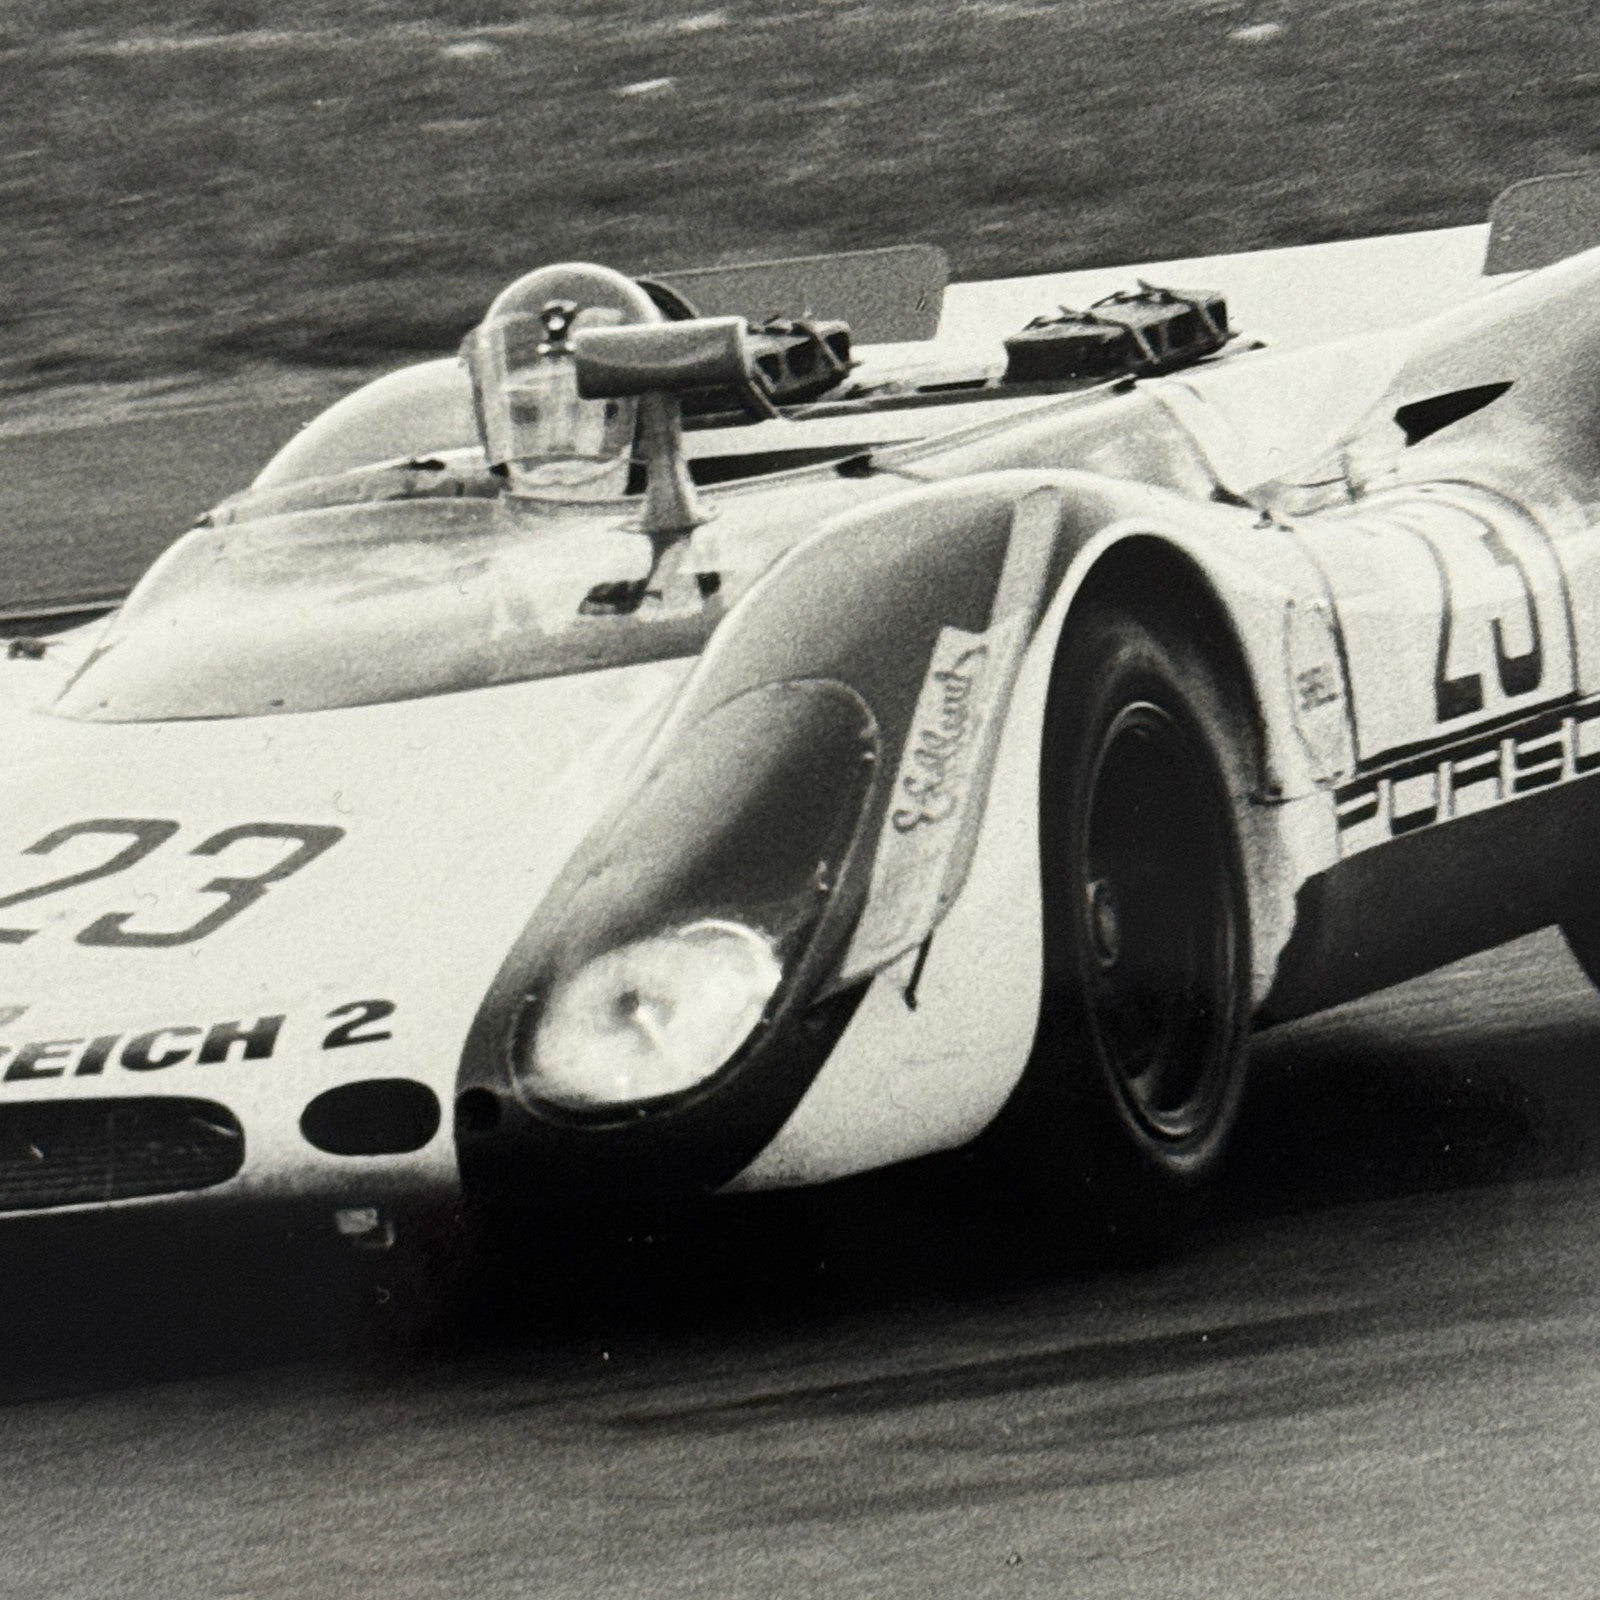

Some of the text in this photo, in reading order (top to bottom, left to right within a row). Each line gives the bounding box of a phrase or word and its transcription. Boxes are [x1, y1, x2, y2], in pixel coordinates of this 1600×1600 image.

[0, 817, 346, 948] 23
[0, 998, 397, 1082] EICH 2
